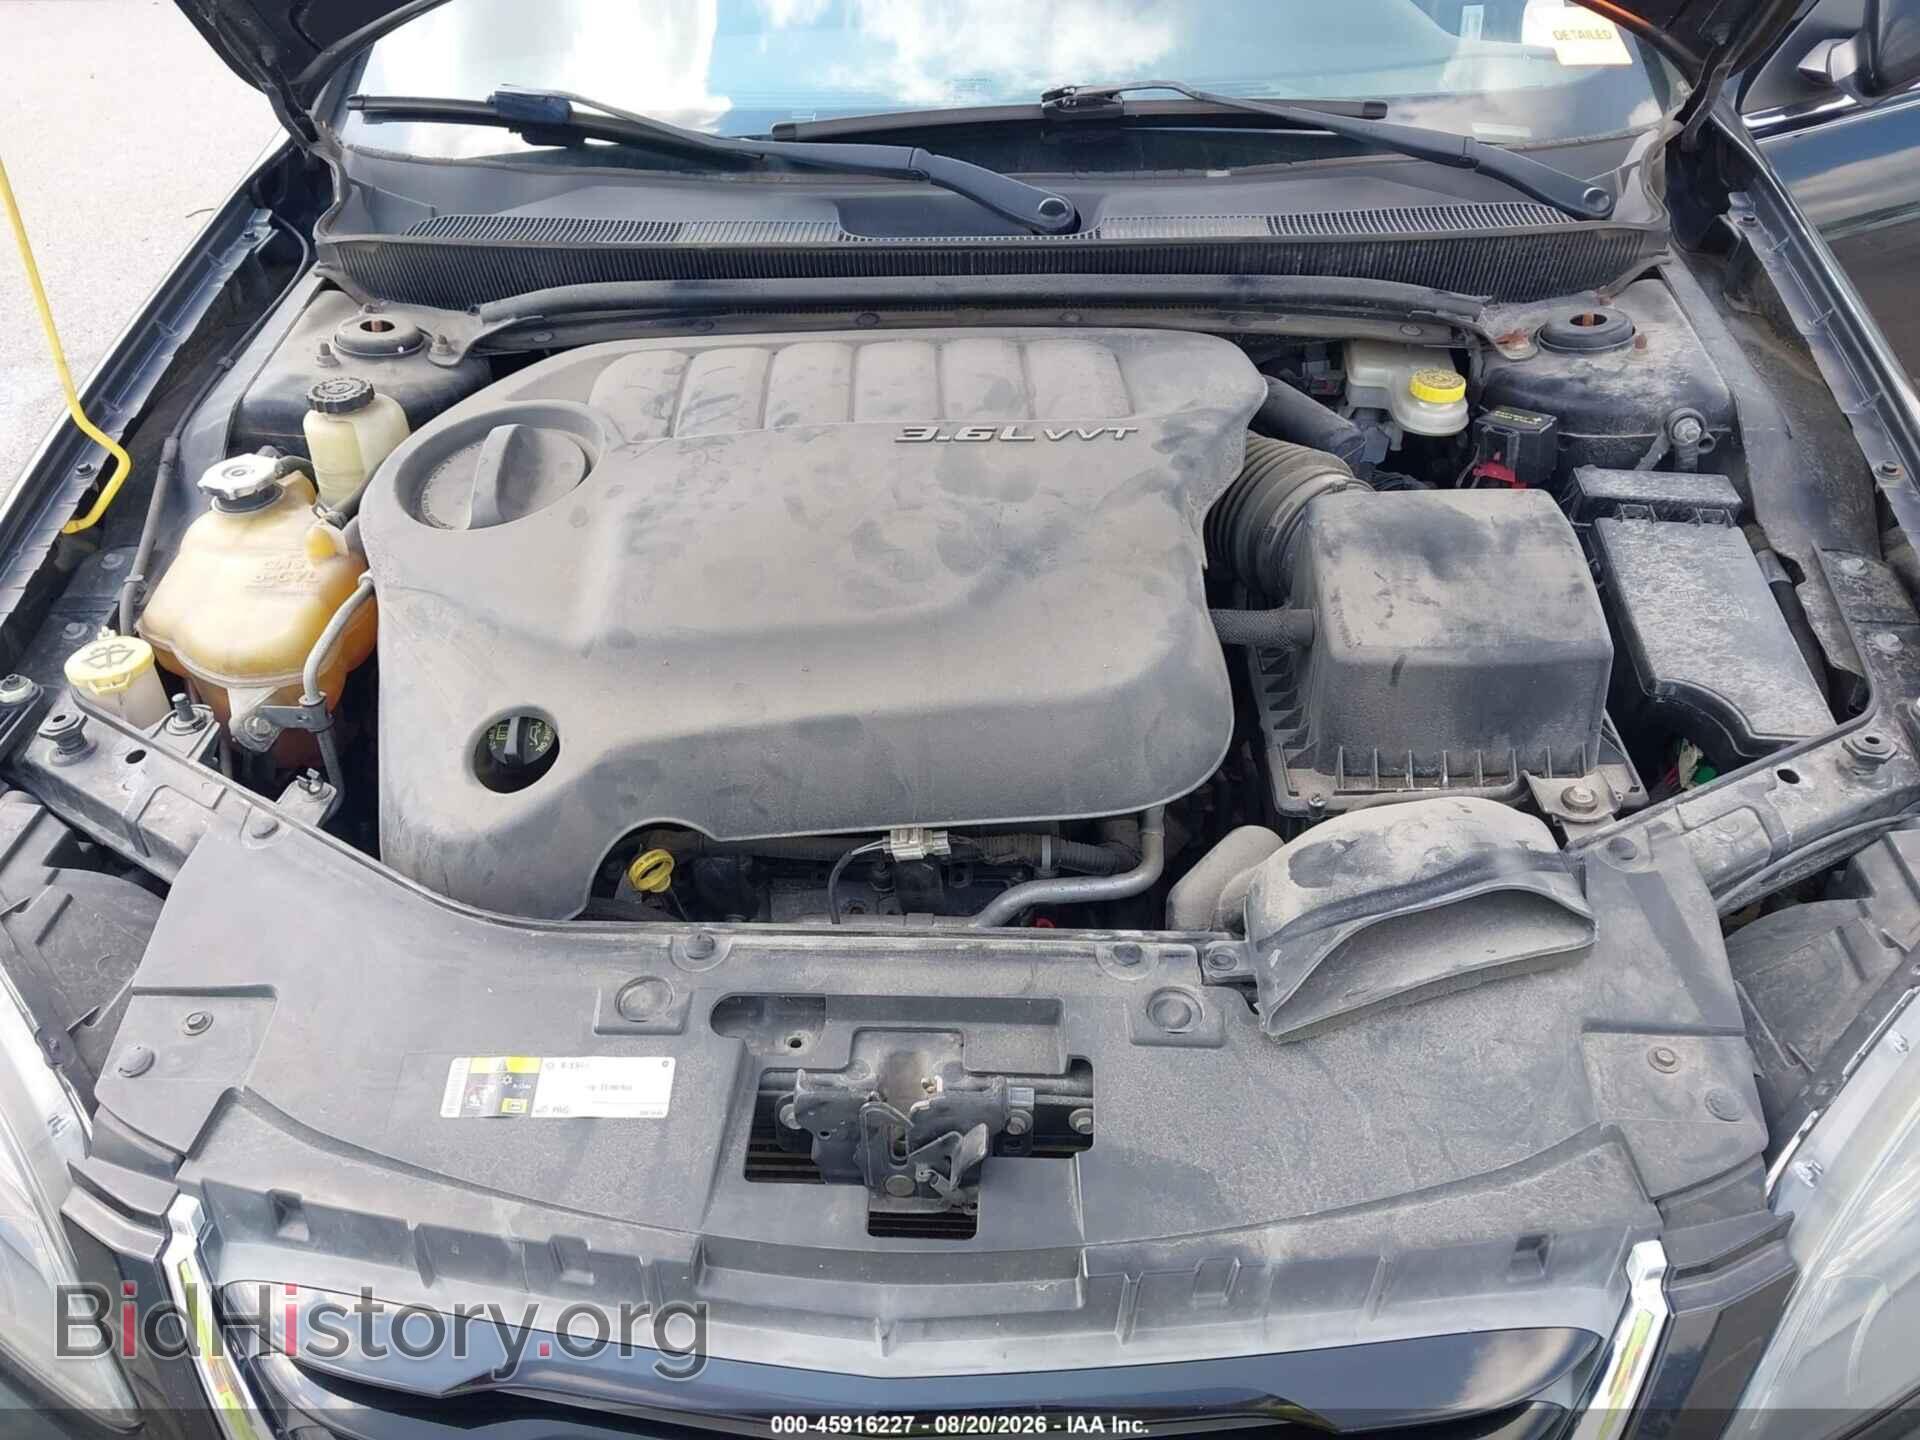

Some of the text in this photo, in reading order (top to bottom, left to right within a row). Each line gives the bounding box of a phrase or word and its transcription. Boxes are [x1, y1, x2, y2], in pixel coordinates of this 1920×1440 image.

[1552, 29, 1612, 41] DETAILED
[895, 425, 1138, 443] 3.6L VVT
